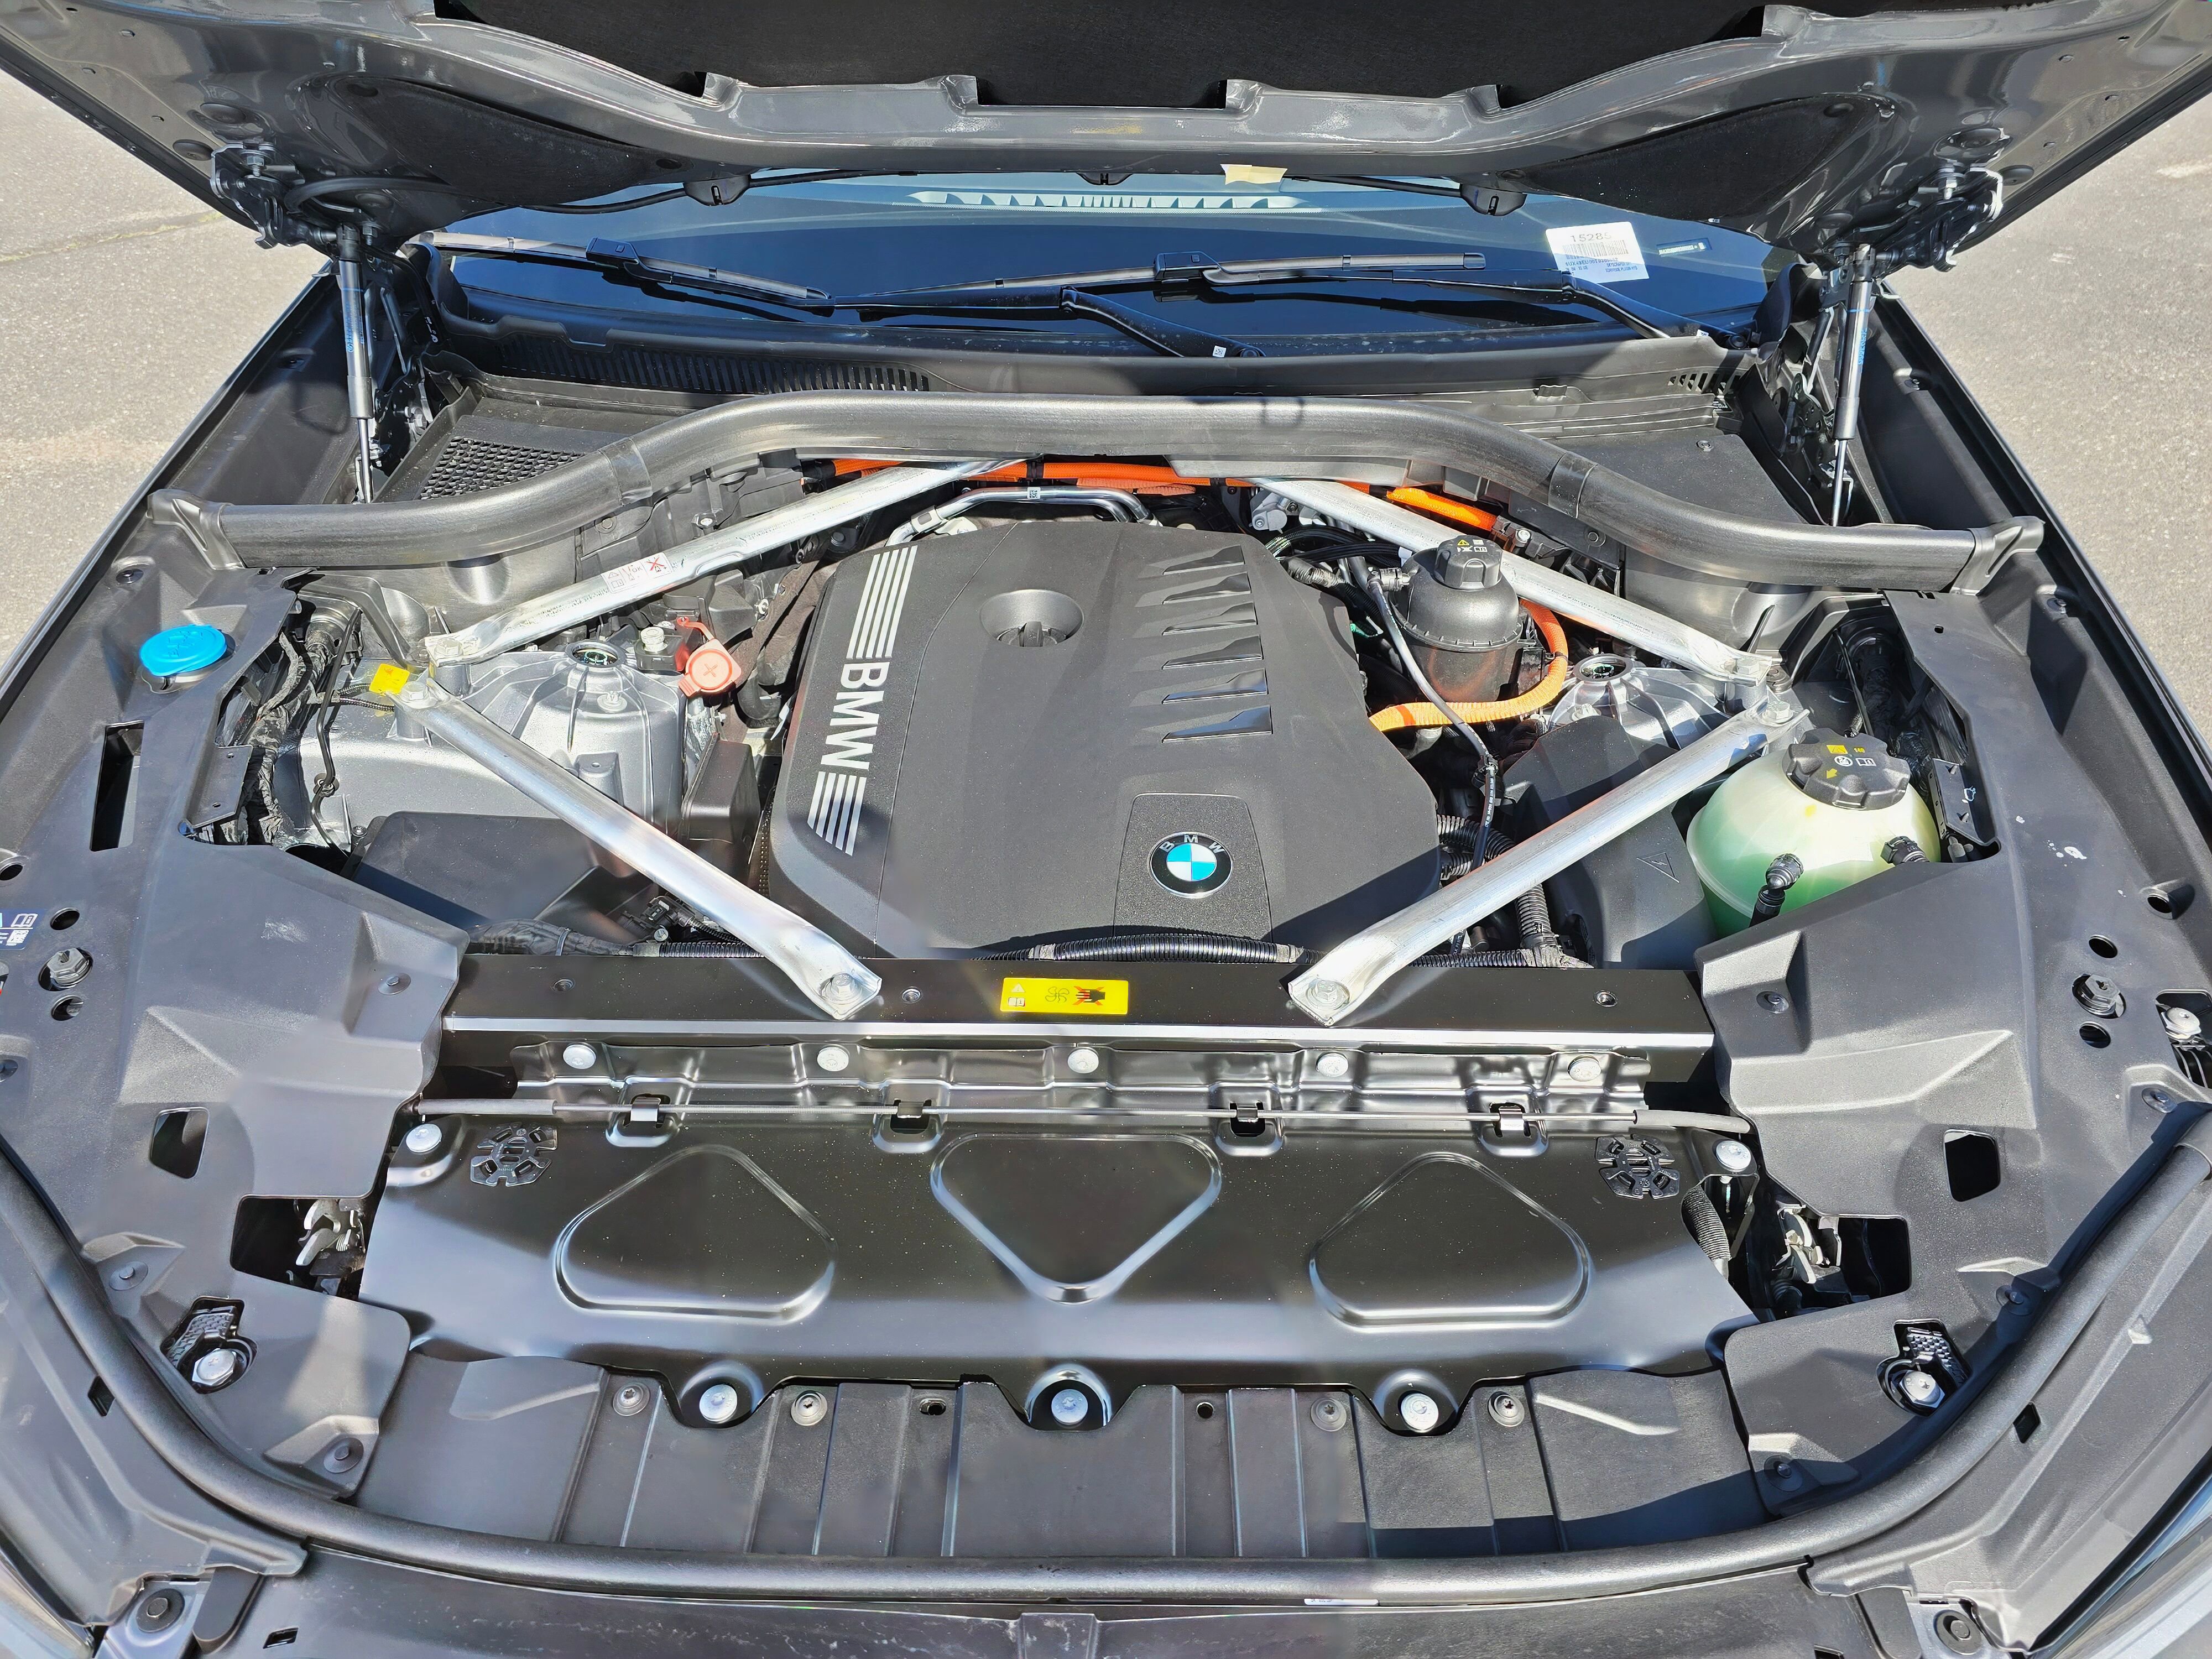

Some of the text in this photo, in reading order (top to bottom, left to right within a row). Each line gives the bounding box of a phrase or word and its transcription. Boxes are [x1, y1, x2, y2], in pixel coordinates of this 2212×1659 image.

[1571, 232, 1611, 242] 15285
[820, 661, 890, 770] BMW
[1160, 835, 1224, 853] BMW
